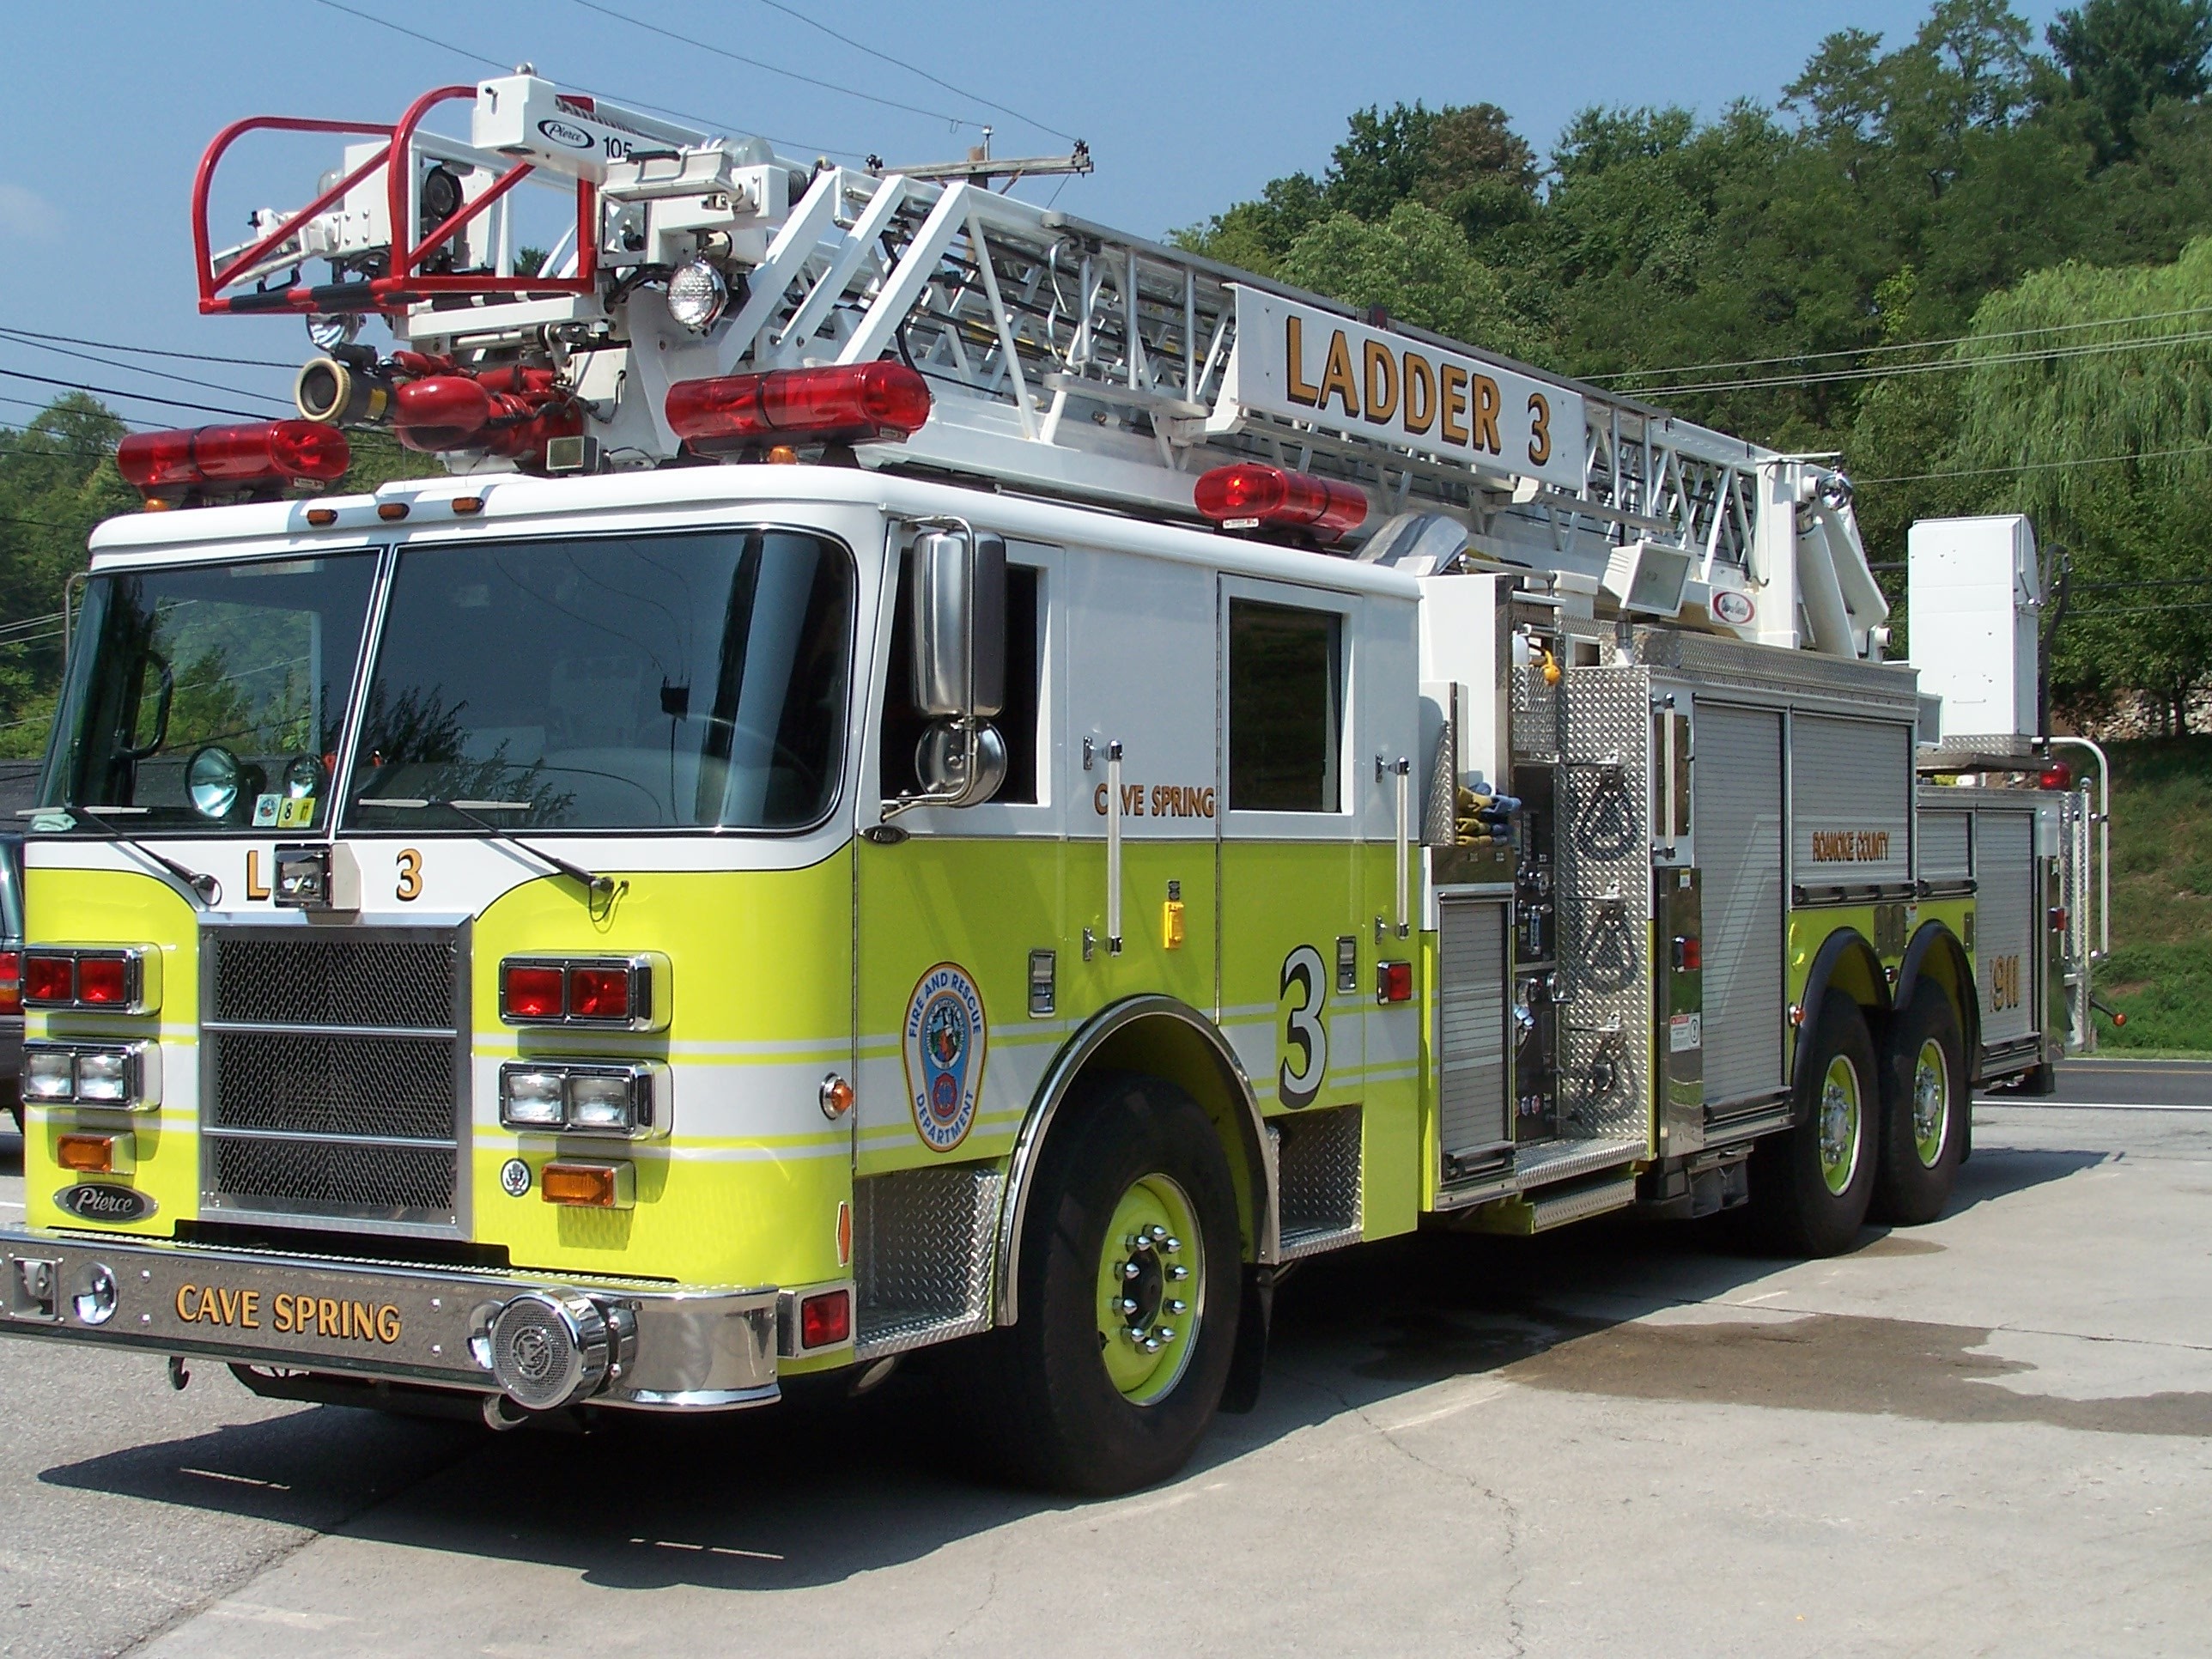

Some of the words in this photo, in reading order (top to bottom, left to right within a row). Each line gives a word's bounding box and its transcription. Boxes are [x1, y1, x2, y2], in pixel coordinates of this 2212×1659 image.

[549, 123, 582, 143] Pierce
[1286, 314, 1502, 456] LADDER
[1528, 392, 1552, 467] 3
[1094, 782, 1144, 816] CVE
[1152, 785, 1215, 817] SPRING
[246, 849, 271, 902] L
[396, 848, 423, 902] 3
[909, 995, 925, 1038] FIRE
[925, 972, 948, 999] AND
[951, 973, 981, 1035] RESCUE
[1279, 945, 1328, 1110] 3
[915, 1089, 974, 1145] DEPARTMENT
[75, 1187, 134, 1214] Pierce
[175, 1283, 260, 1328] CAVE
[273, 1291, 403, 1345] SPRING
